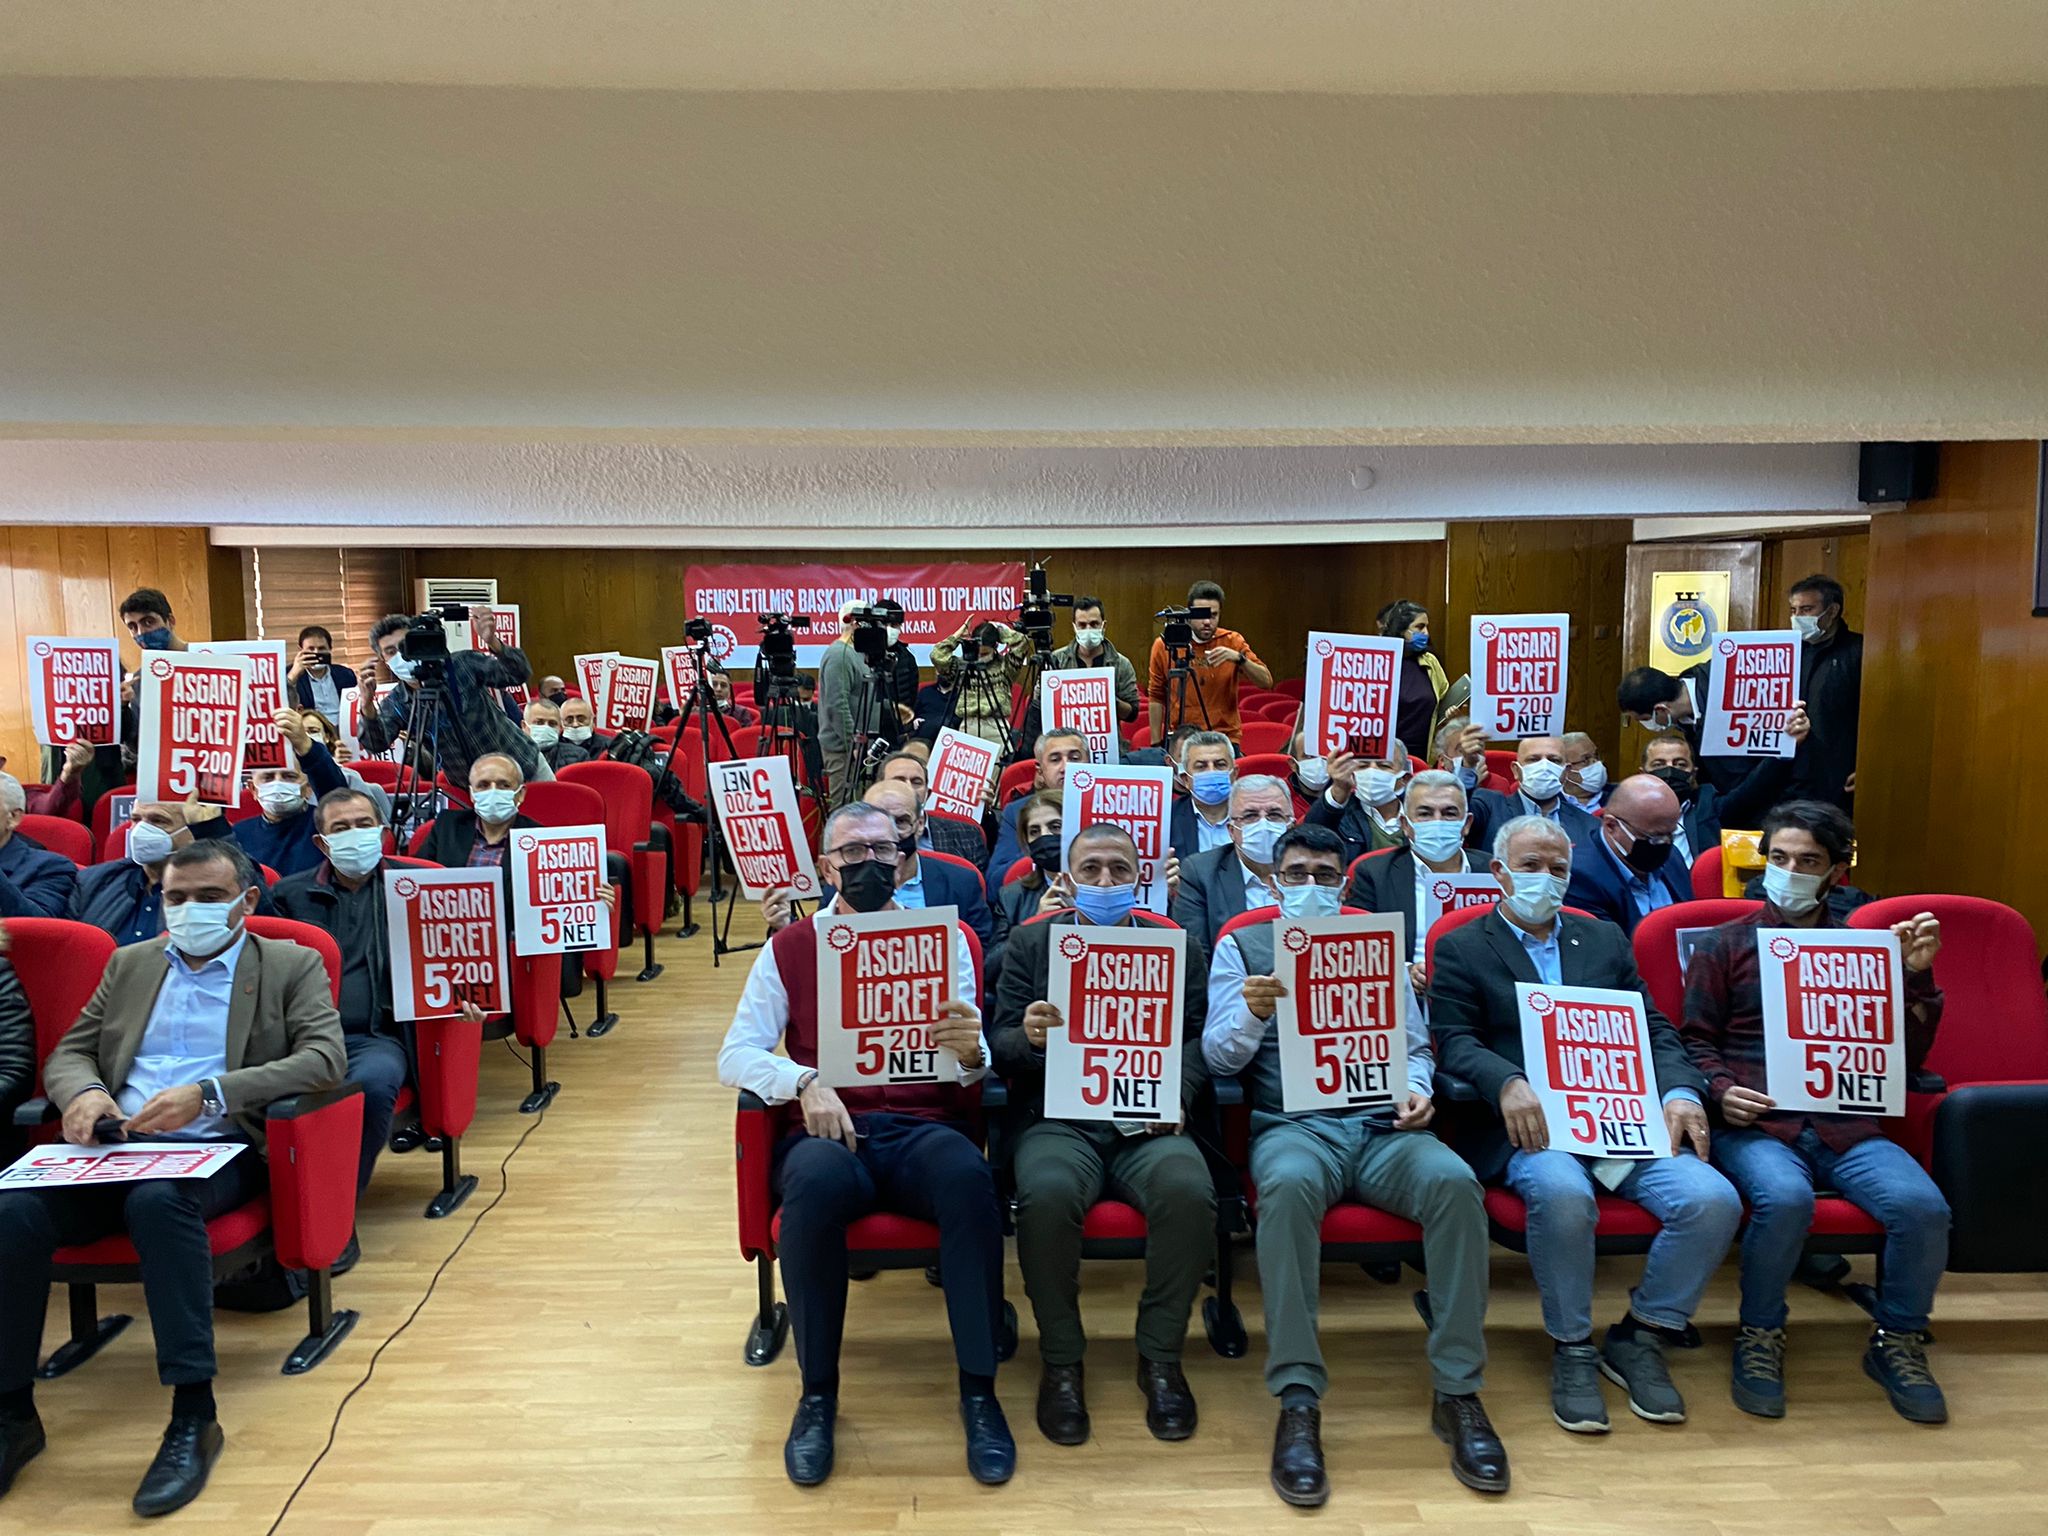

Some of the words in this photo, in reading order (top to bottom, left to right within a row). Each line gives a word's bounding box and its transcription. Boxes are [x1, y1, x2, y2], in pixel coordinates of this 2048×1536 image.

[940, 586, 1015, 612] TOPLANTISI
[1496, 661, 1557, 692] ÜCRET
[1733, 677, 1791, 708] ÜCRET
[1329, 679, 1388, 714] ÜCRET
[54, 707, 75, 740] 5
[75, 707, 110, 725] 200
[172, 706, 237, 746] ÜCRET
[610, 703, 625, 727] 5
[625, 705, 646, 719] 200
[1495, 698, 1515, 733] 5
[1519, 697, 1553, 714] 200
[1517, 714, 1552, 732] NET
[1727, 713, 1748, 747] 5
[1751, 713, 1786, 730] 200
[1090, 736, 1108, 751] 00
[1327, 714, 1347, 752] 5
[1348, 717, 1384, 737] 200
[1747, 730, 1783, 748] NET
[168, 748, 197, 794] 5
[197, 750, 232, 775] 200
[1093, 751, 1108, 764] ET
[723, 770, 751, 792] NET
[753, 768, 773, 810] 5
[725, 793, 755, 814] 200
[538, 871, 597, 903] ÜCRET
[421, 921, 492, 958] ÜCRET
[541, 907, 560, 944] 5
[563, 905, 596, 924] 200
[563, 924, 596, 943] NET
[424, 963, 451, 1008] 5
[451, 962, 494, 984] 200
[858, 977, 944, 1024] ÜCRET
[1083, 995, 1168, 1043] ÜCRET
[1310, 981, 1390, 1030] ÜCRET
[1801, 992, 1887, 1040] ÜCRET
[856, 1030, 885, 1076] 5
[889, 1050, 939, 1074] NET
[1314, 1037, 1341, 1094] 5
[1343, 1034, 1390, 1063] 200
[1558, 1045, 1639, 1092] ÜCRET
[1081, 1048, 1109, 1106] 5
[1114, 1049, 1162, 1079] 200
[1345, 1063, 1391, 1093] NET
[1805, 1044, 1834, 1099] 5
[1837, 1046, 1887, 1074] 200
[1838, 1073, 1887, 1103] NET
[1113, 1078, 1161, 1108] NET
[1566, 1094, 1597, 1144] 5
[1596, 1097, 1645, 1122] 200
[1600, 1121, 1647, 1147] NET
